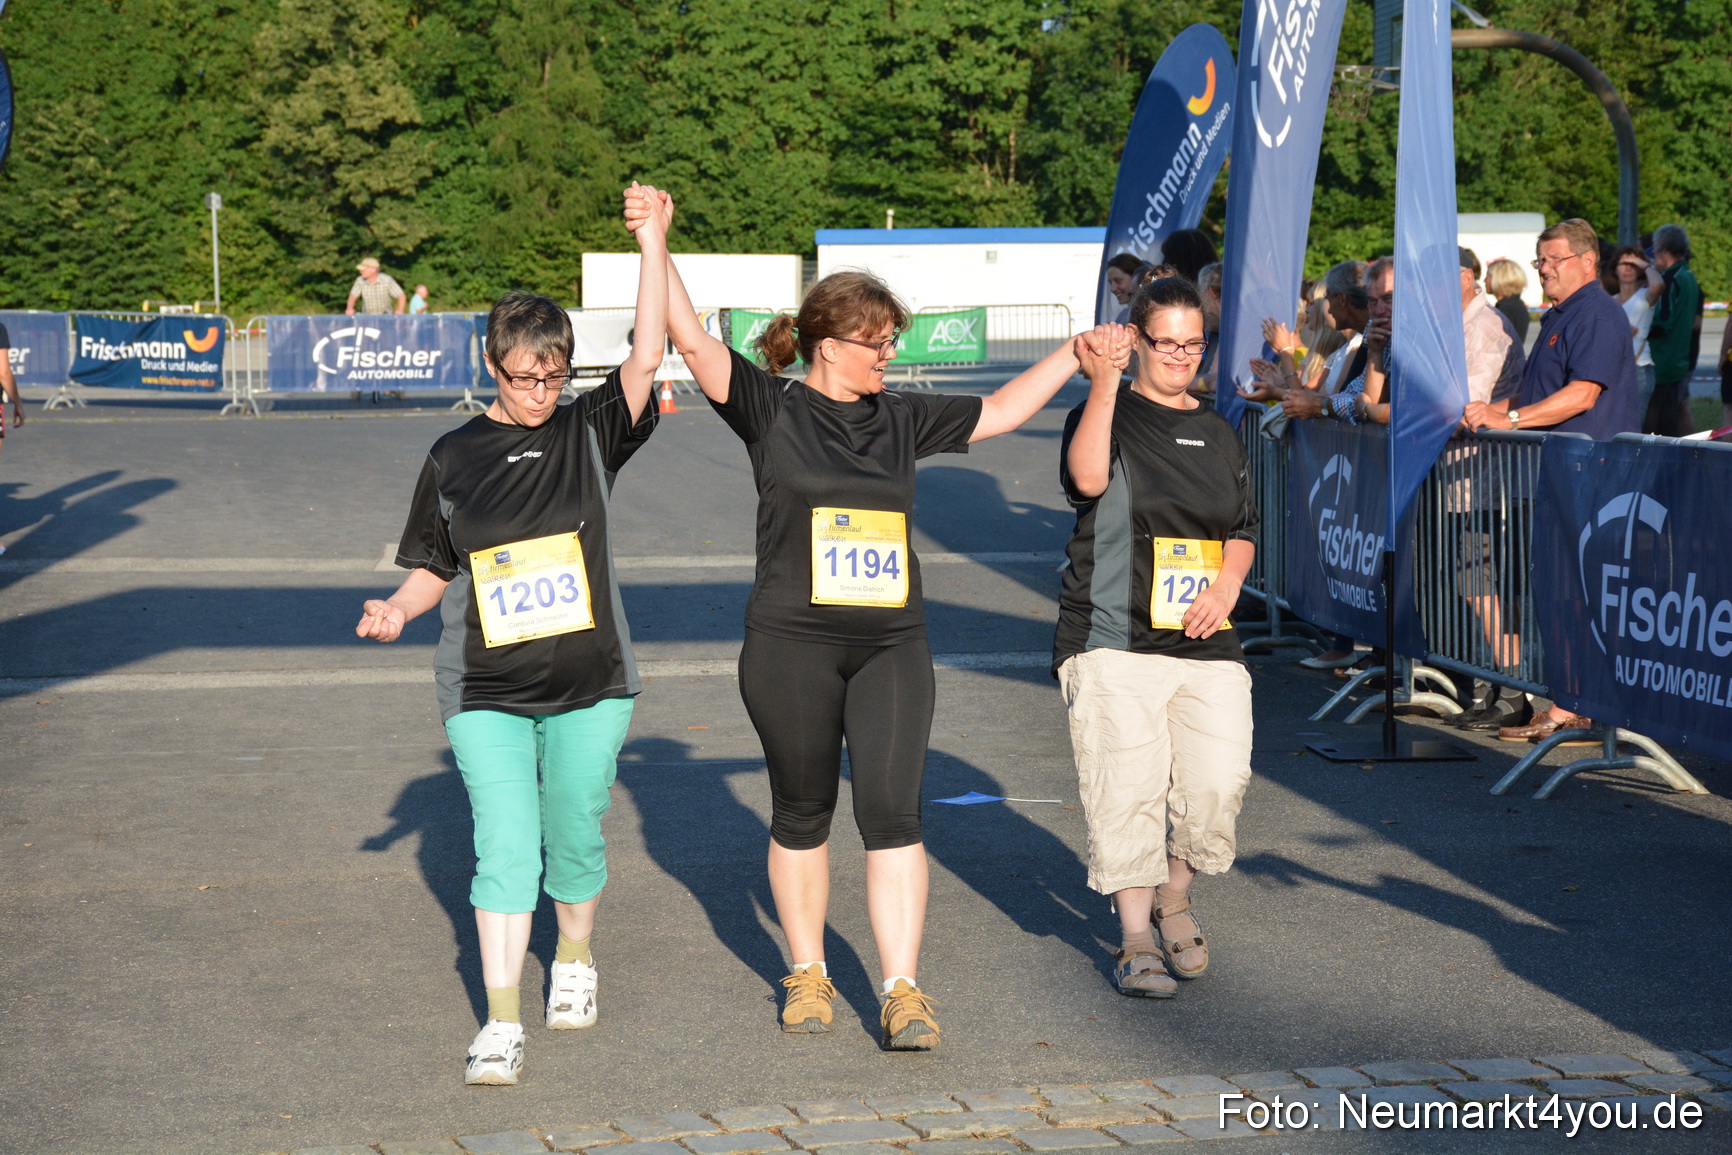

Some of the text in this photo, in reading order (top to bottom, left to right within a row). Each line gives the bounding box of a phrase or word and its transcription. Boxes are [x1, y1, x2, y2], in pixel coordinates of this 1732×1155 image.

[1268, 0, 1306, 105] Fis
[1179, 102, 1231, 204] Druck und Medien
[1116, 122, 1203, 260] rischmann
[928, 317, 978, 344] AOK
[81, 336, 186, 361] Frischmann
[337, 345, 441, 368] Fischer
[141, 358, 219, 373] Druck und Medien
[347, 369, 434, 380] AUTOMOBILE
[829, 524, 862, 533] firmenlauf
[1318, 508, 1385, 577] Fischer
[824, 546, 900, 580] 1194
[490, 573, 579, 616] 1203
[840, 584, 885, 593] Simone Dietrich
[1163, 575, 1210, 604] 120
[1601, 563, 1732, 658] Fische
[1615, 654, 1732, 709] AUTOMOBIL
